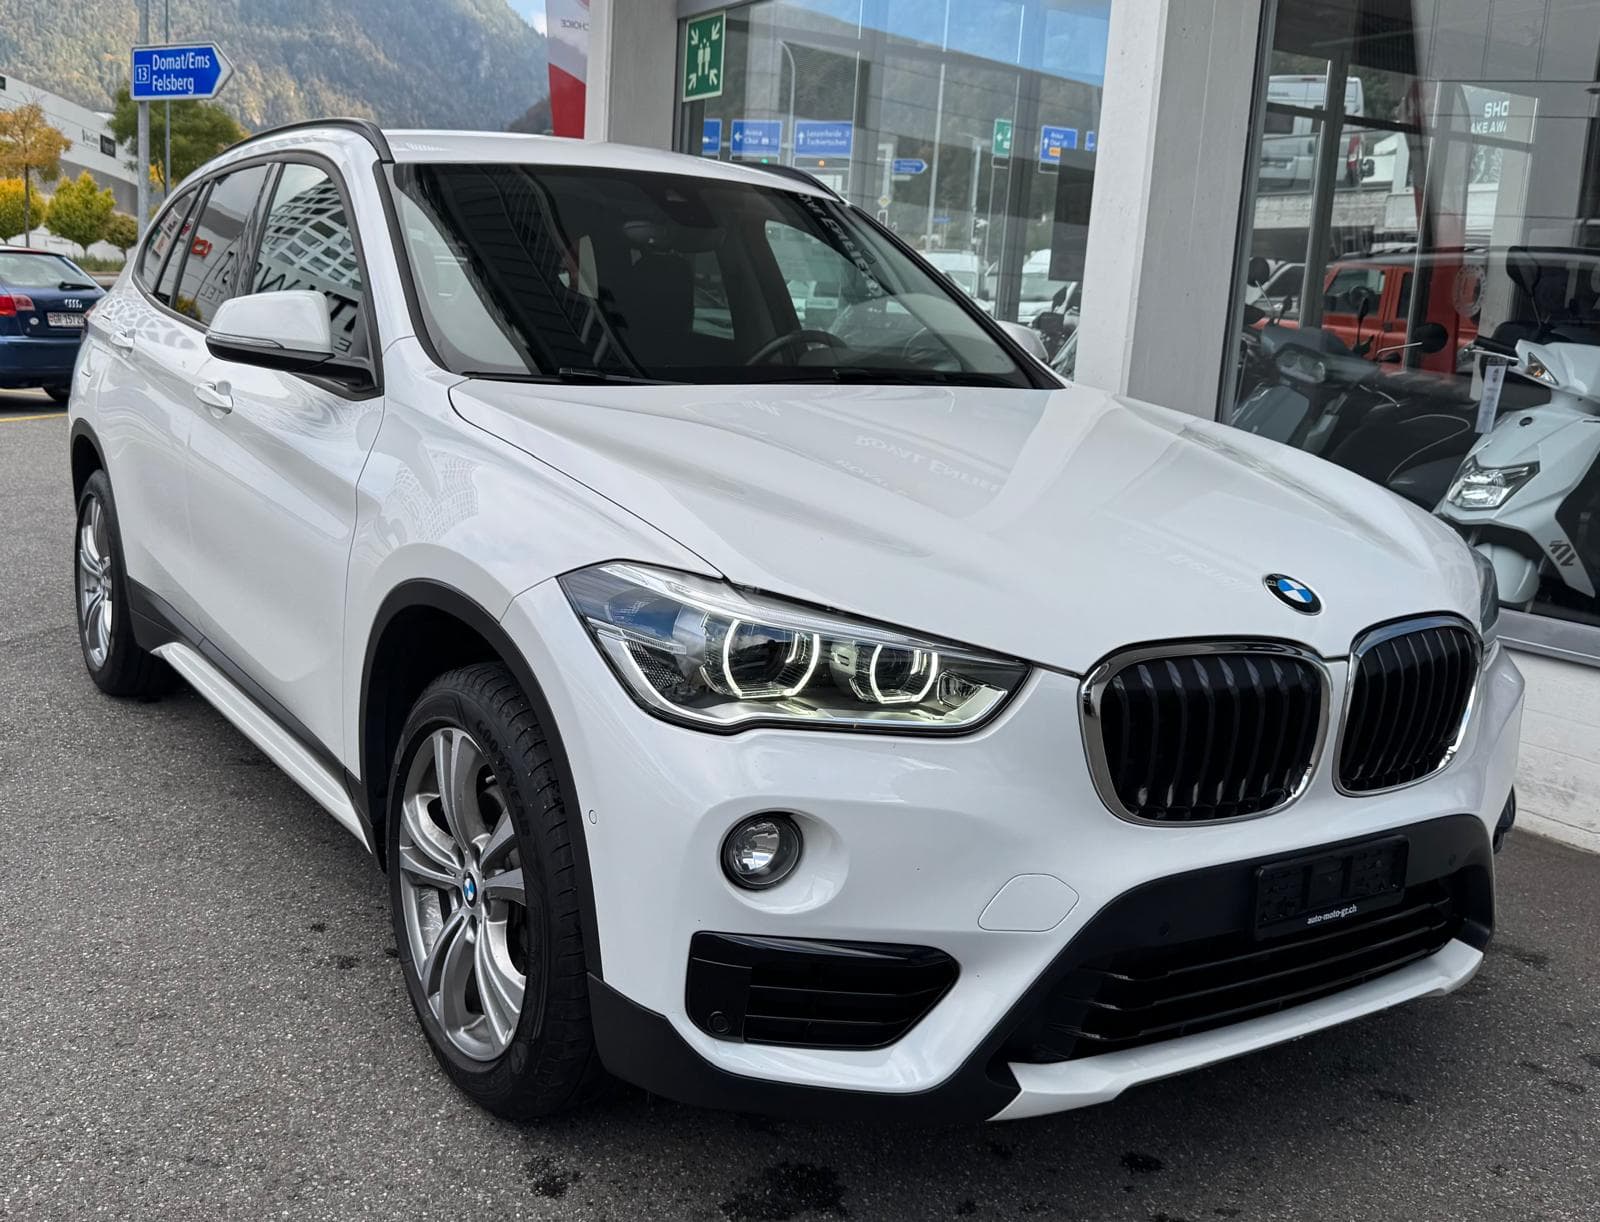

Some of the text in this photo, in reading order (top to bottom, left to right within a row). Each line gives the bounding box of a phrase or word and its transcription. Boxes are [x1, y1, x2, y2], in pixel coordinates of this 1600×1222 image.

[152, 53, 210, 71] Domat/Ems
[138, 67, 148, 81] 13
[152, 74, 195, 94] Felsberg
